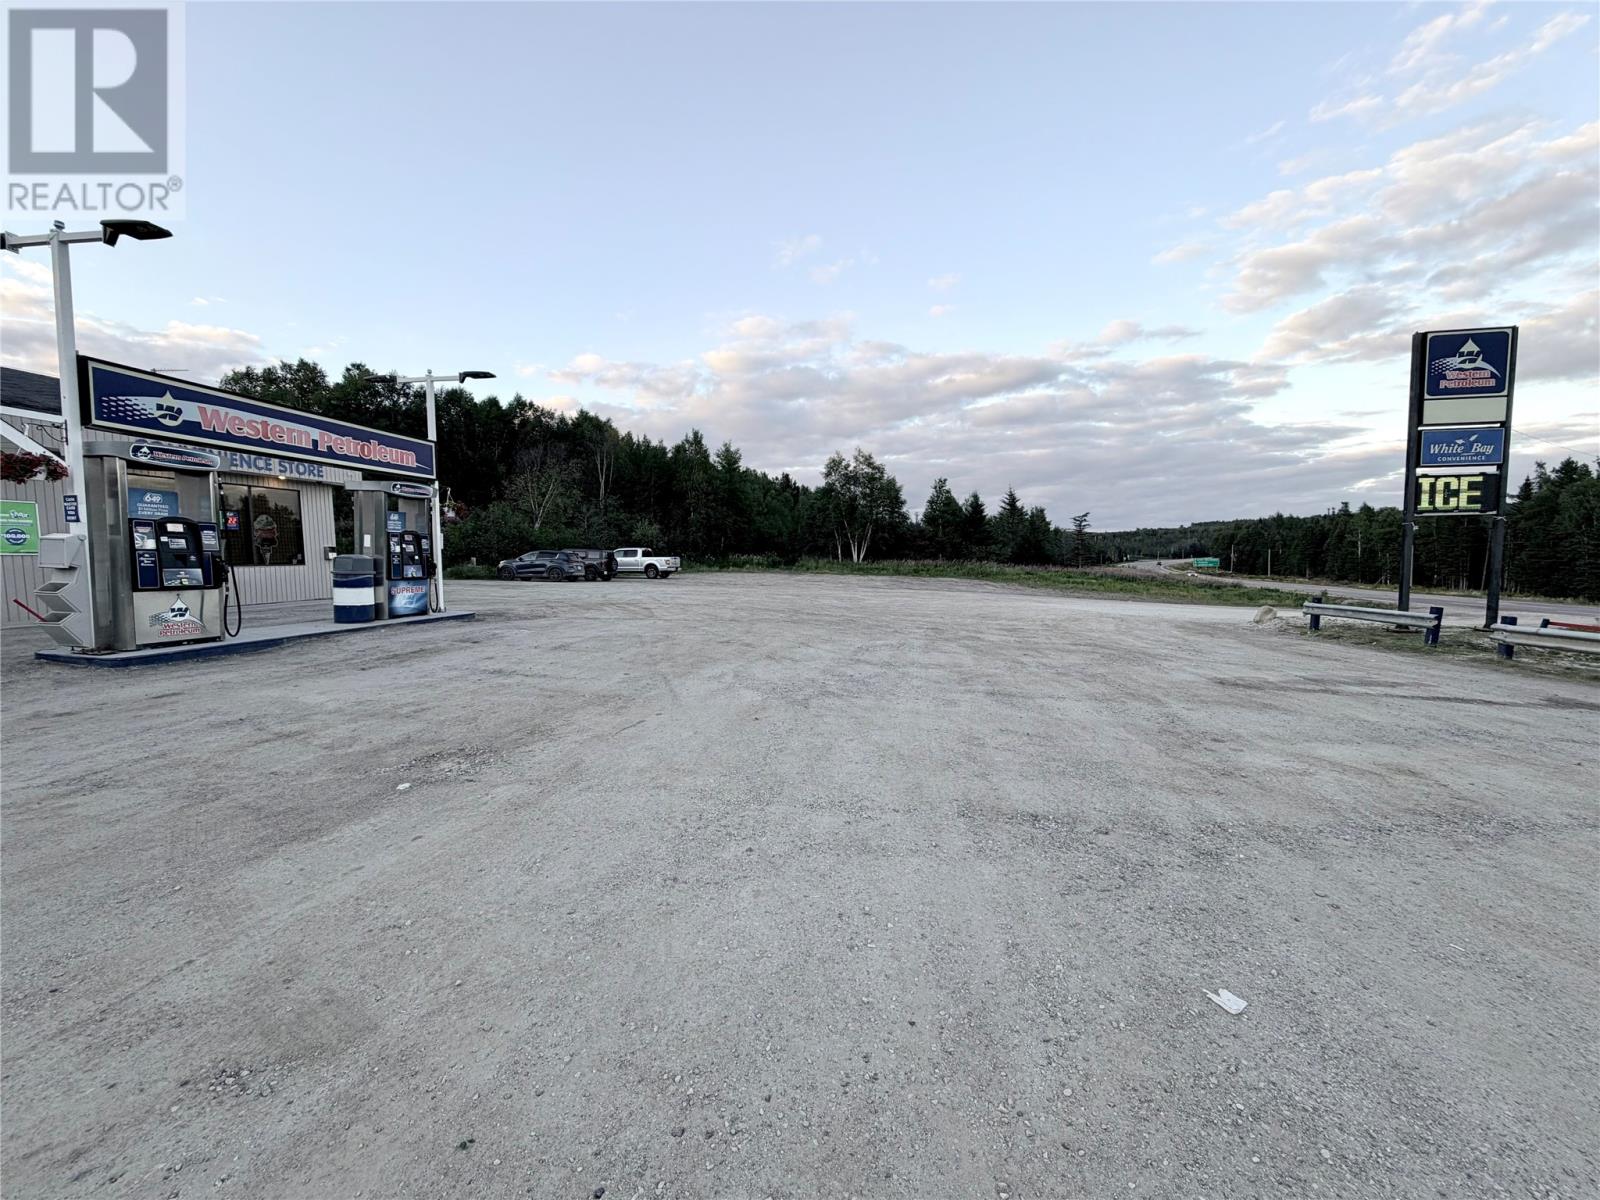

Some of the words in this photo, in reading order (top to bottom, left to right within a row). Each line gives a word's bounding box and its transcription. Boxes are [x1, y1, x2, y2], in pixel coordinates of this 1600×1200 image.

[1445, 370, 1491, 380] Western
[1439, 378, 1496, 389] Petroleum
[198, 405, 312, 449] Western
[317, 431, 417, 468] Petroleum
[1430, 443, 1465, 454] White
[1472, 442, 1495, 455] Bay
[278, 460, 324, 478] STORE
[1417, 475, 1484, 511] ICE
